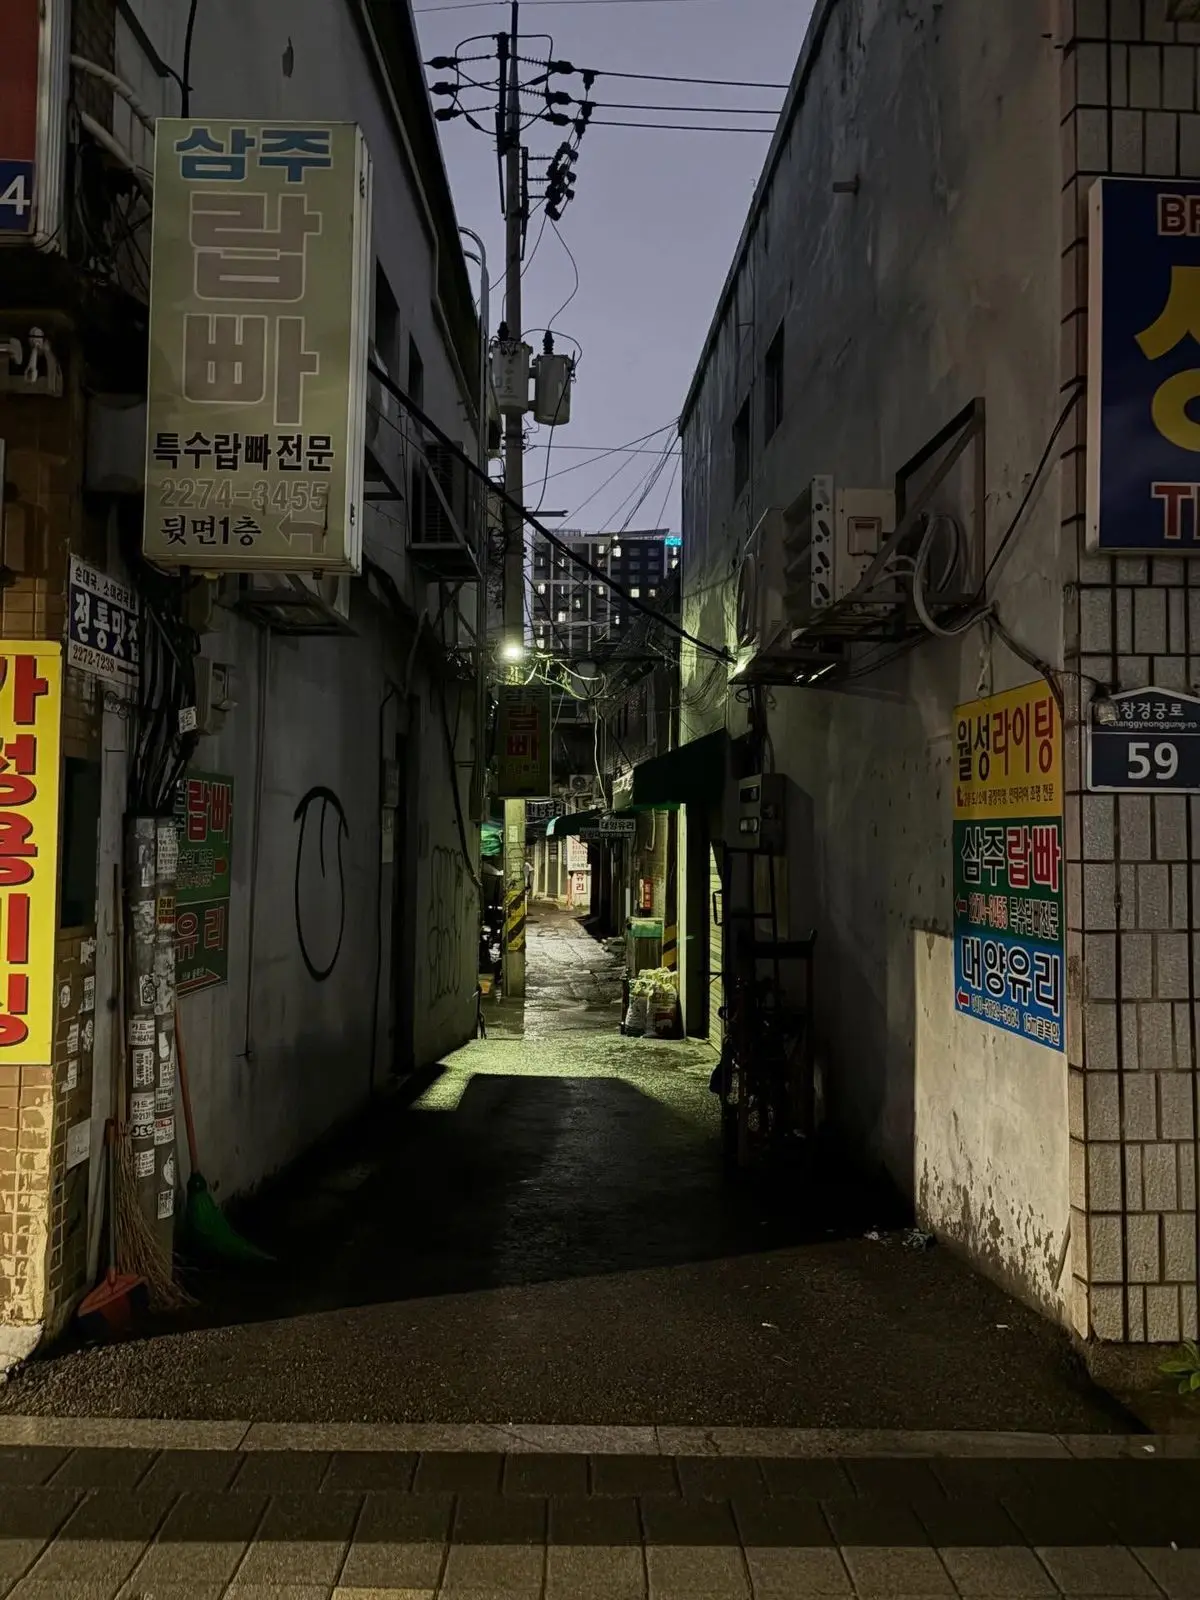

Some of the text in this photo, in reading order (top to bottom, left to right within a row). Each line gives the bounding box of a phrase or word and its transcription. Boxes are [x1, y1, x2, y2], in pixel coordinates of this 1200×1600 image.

[174, 127, 333, 184] 삼주
[159, 478, 329, 513] 2274-3455
[160, 514, 262, 546] 뒷면1층
[72, 643, 115, 674] 2272-7238
[1110, 720, 1198, 729] hanggyeonggung-ro
[1120, 701, 1185, 719] 창경궁로
[956, 696, 1054, 782] 월성라이팅
[1127, 741, 1179, 780] 59
[961, 935, 1061, 1018] 대양유리
